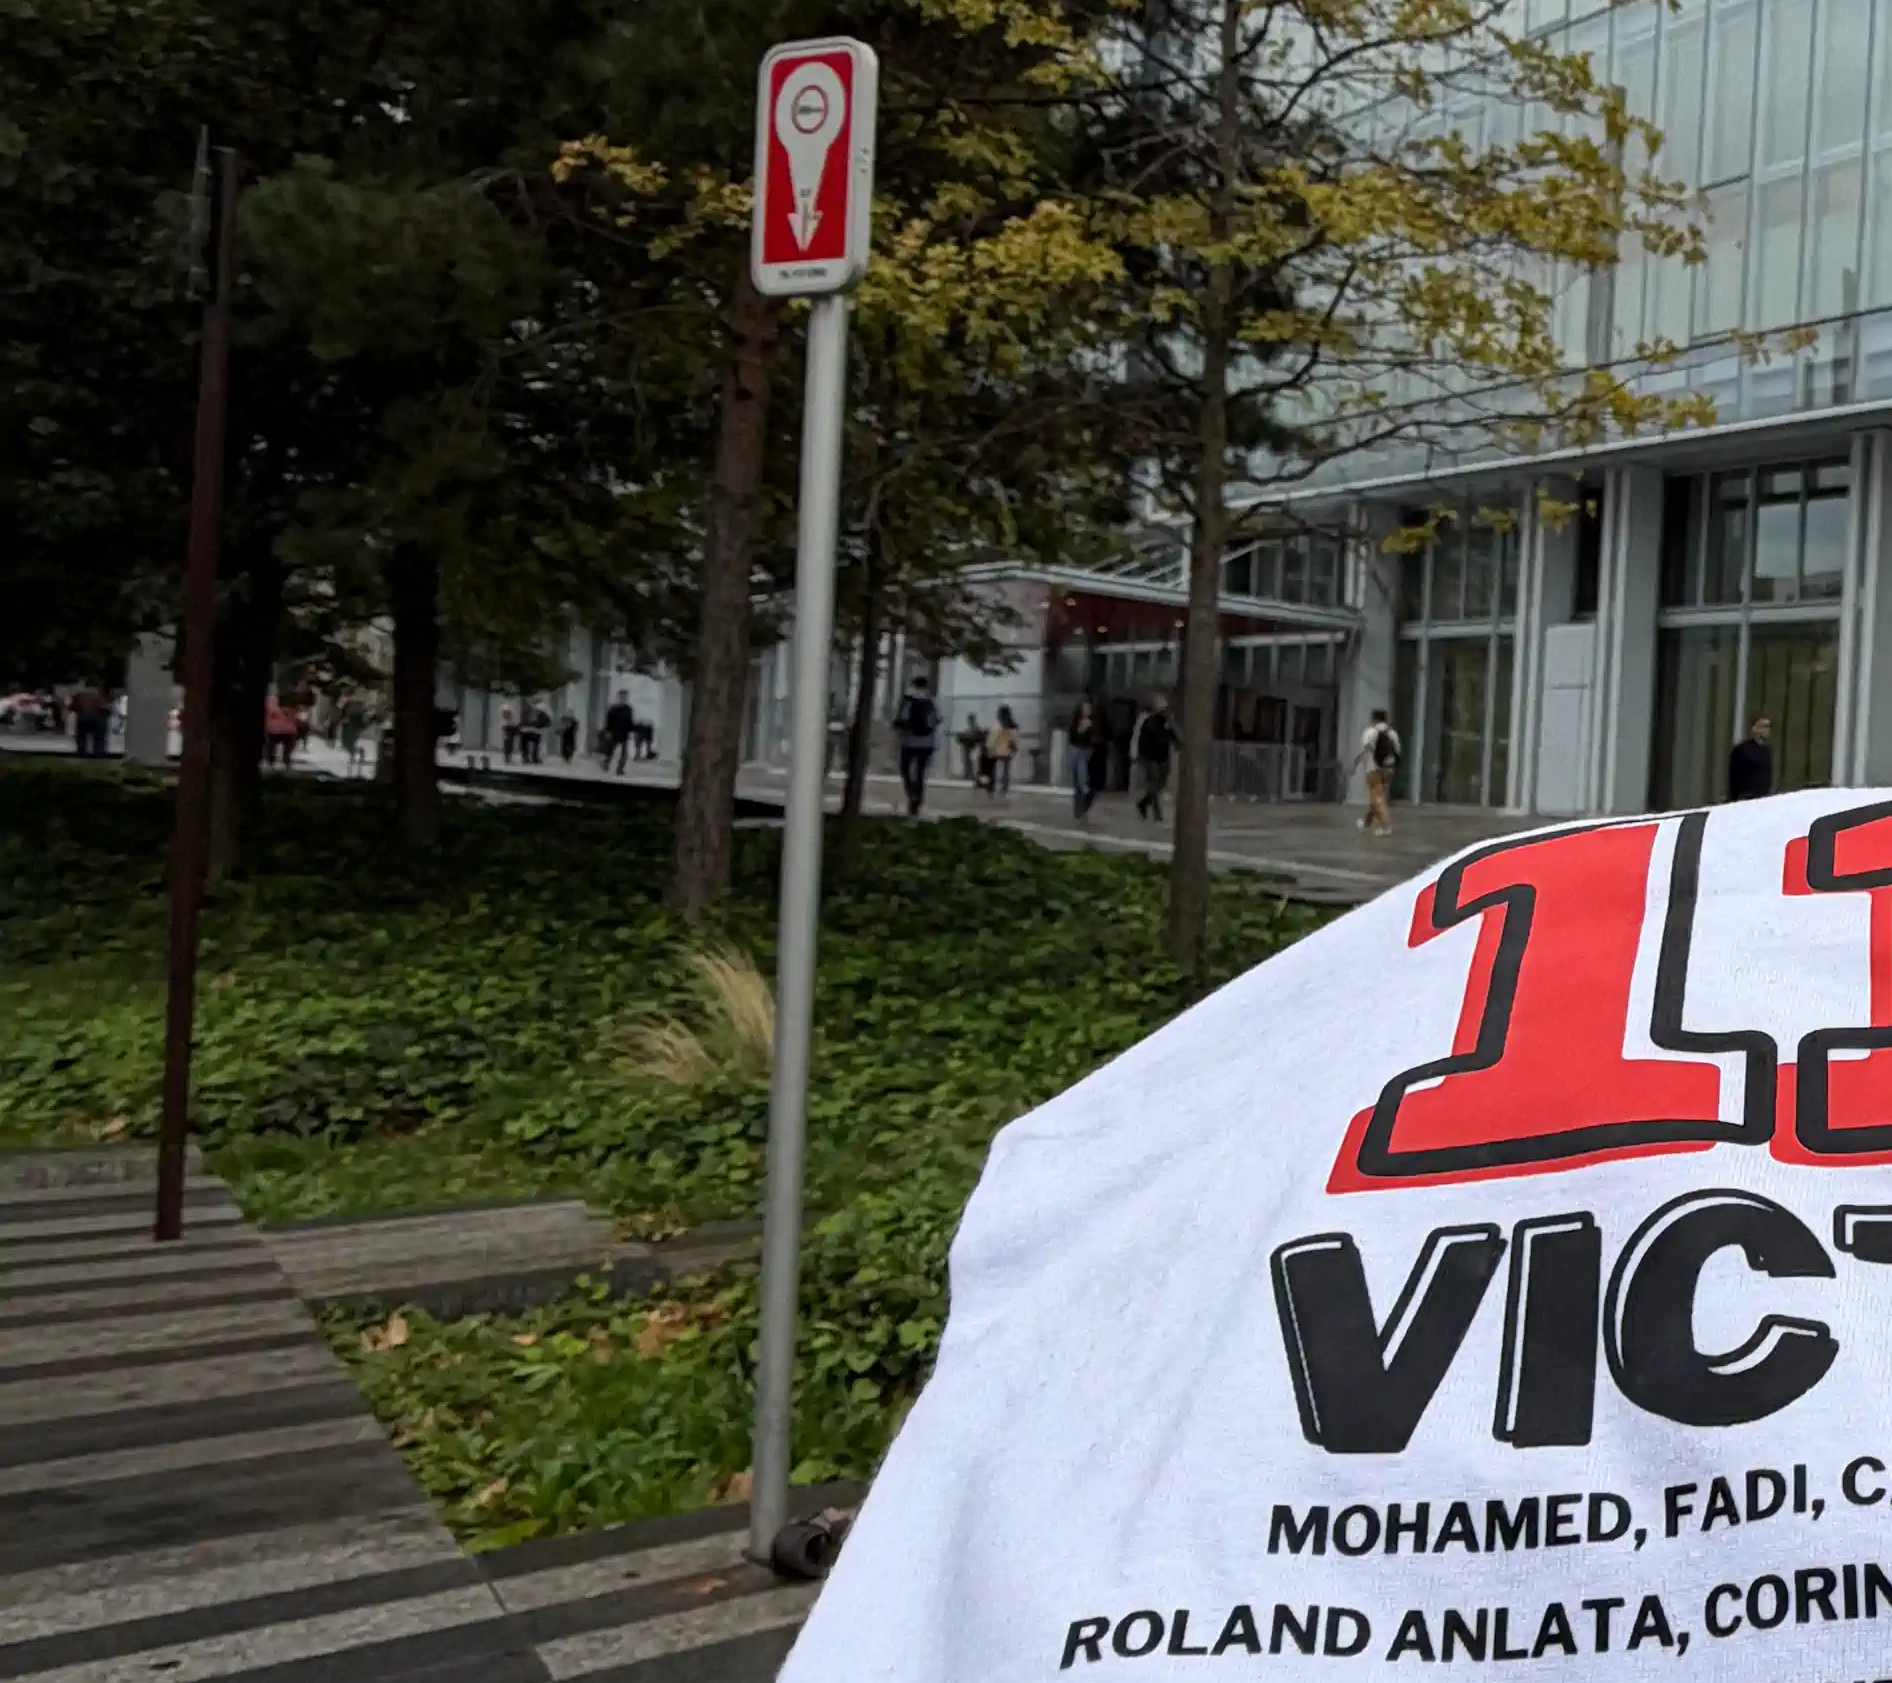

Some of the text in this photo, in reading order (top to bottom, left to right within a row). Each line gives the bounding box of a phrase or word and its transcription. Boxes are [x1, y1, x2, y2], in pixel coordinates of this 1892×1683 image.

[1266, 1491, 1648, 1558] MOHAMED,
[1663, 1463, 1826, 1540] FADI,
[1058, 1603, 1372, 1671] ROLAND
[1384, 1593, 1691, 1664] ANLATA,
